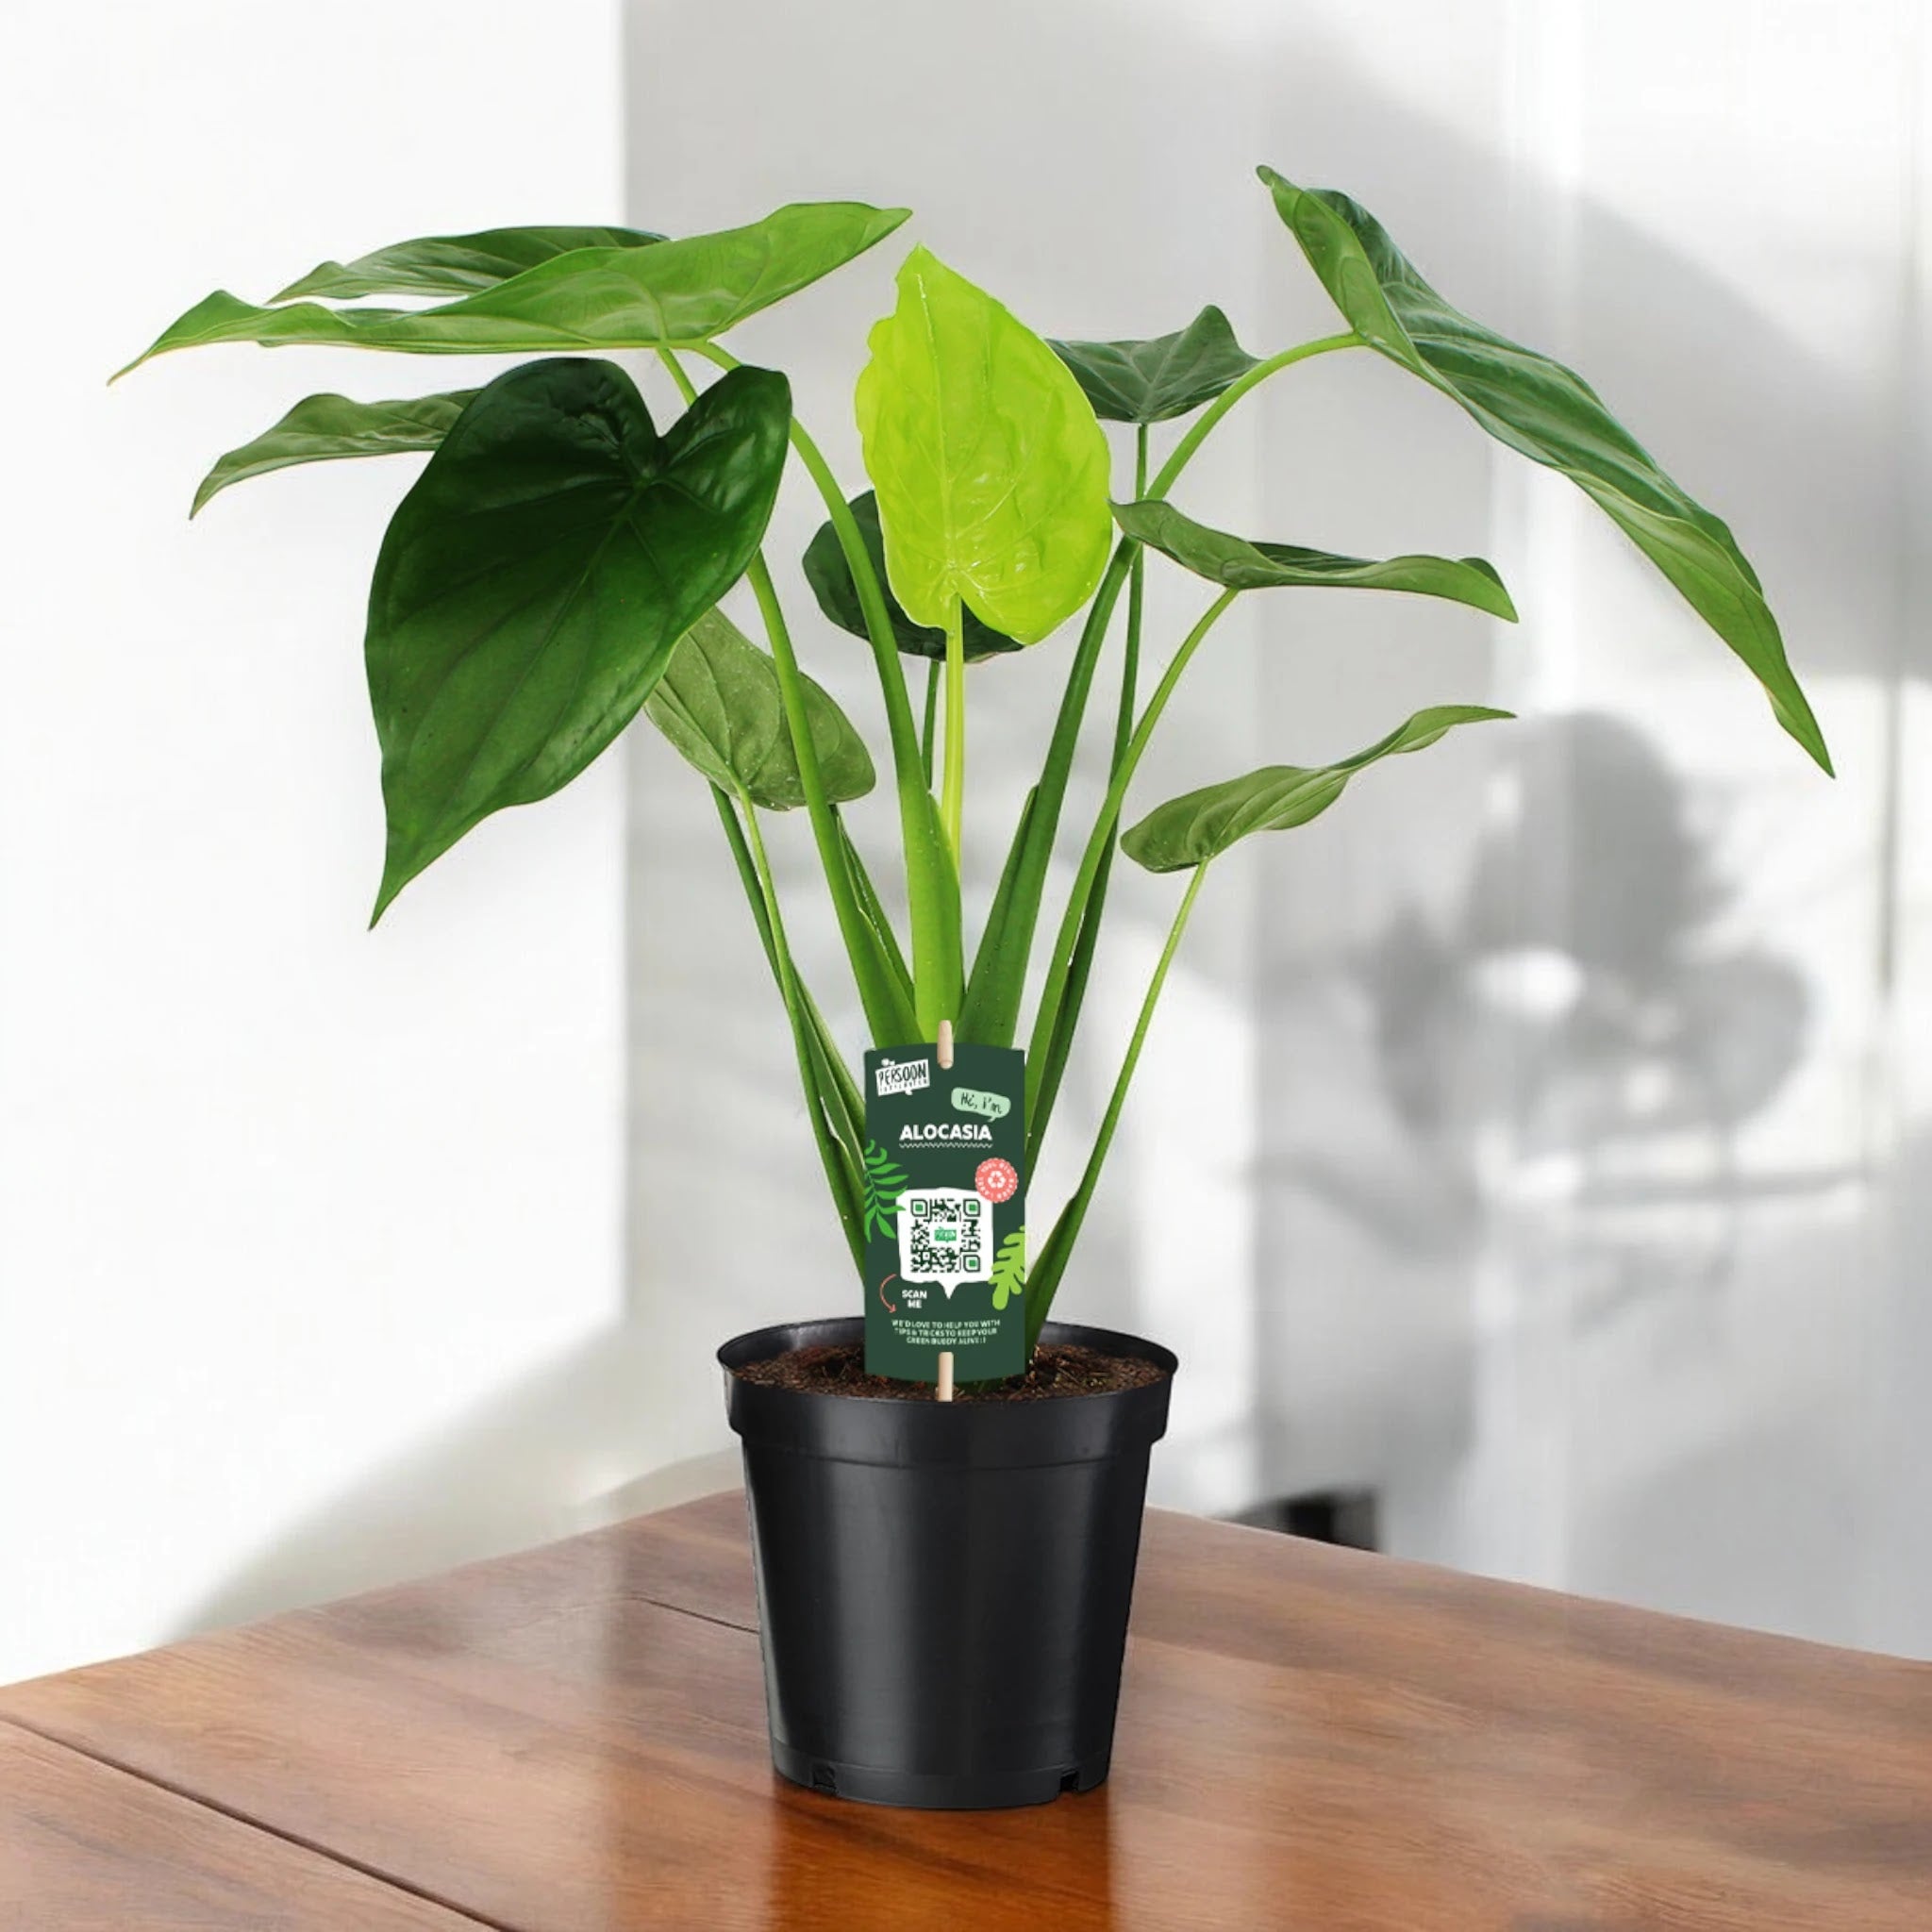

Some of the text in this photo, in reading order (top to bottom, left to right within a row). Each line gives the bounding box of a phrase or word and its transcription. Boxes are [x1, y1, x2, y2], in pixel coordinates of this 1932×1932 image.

[878, 1062, 926, 1085] PERSOON
[899, 1124, 992, 1141] ALOCASIA
[901, 1289, 927, 1299] SCAN
[908, 1299, 923, 1308] ME
[911, 1321, 930, 1329] LOVE
[945, 1329, 957, 1338] TO
[976, 1327, 998, 1336] YOUR
